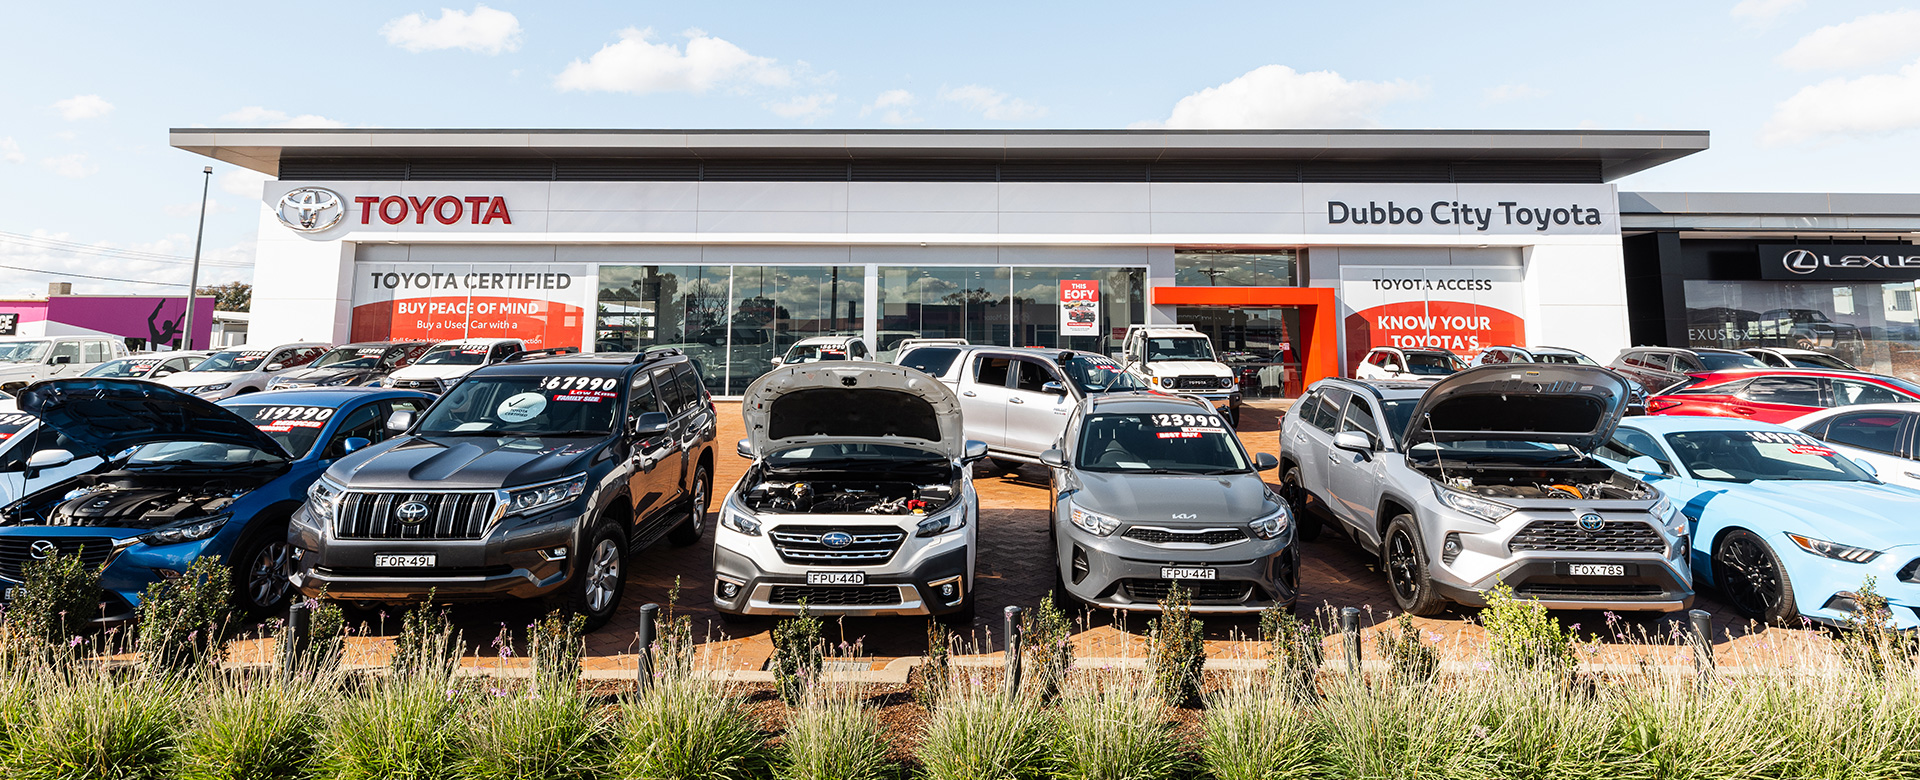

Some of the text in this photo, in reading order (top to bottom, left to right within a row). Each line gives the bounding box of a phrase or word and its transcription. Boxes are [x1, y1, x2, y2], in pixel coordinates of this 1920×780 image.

[355, 195, 511, 225] TOYOTA
[1327, 201, 1602, 231] Dubbo City Toyota
[1822, 255, 1920, 268] LEXUS
[371, 272, 572, 290] TOYOTA CERTIFIED
[1372, 278, 1492, 291] TOYOTA ACCESS
[1064, 289, 1094, 299] EOFY
[398, 302, 539, 315] BUY PEACE OF MIND
[417, 320, 434, 331] Buy
[444, 319, 467, 329] Used
[470, 320, 487, 329] Car
[489, 319, 510, 329] with
[1378, 315, 1491, 331] KNOW YOUR
[1731, 329, 1751, 340] GX
[1391, 335, 1479, 350] TOYOTA'S
[539, 376, 617, 391] $67990
[255, 406, 334, 420] $19990
[1151, 413, 1221, 427] $23990
